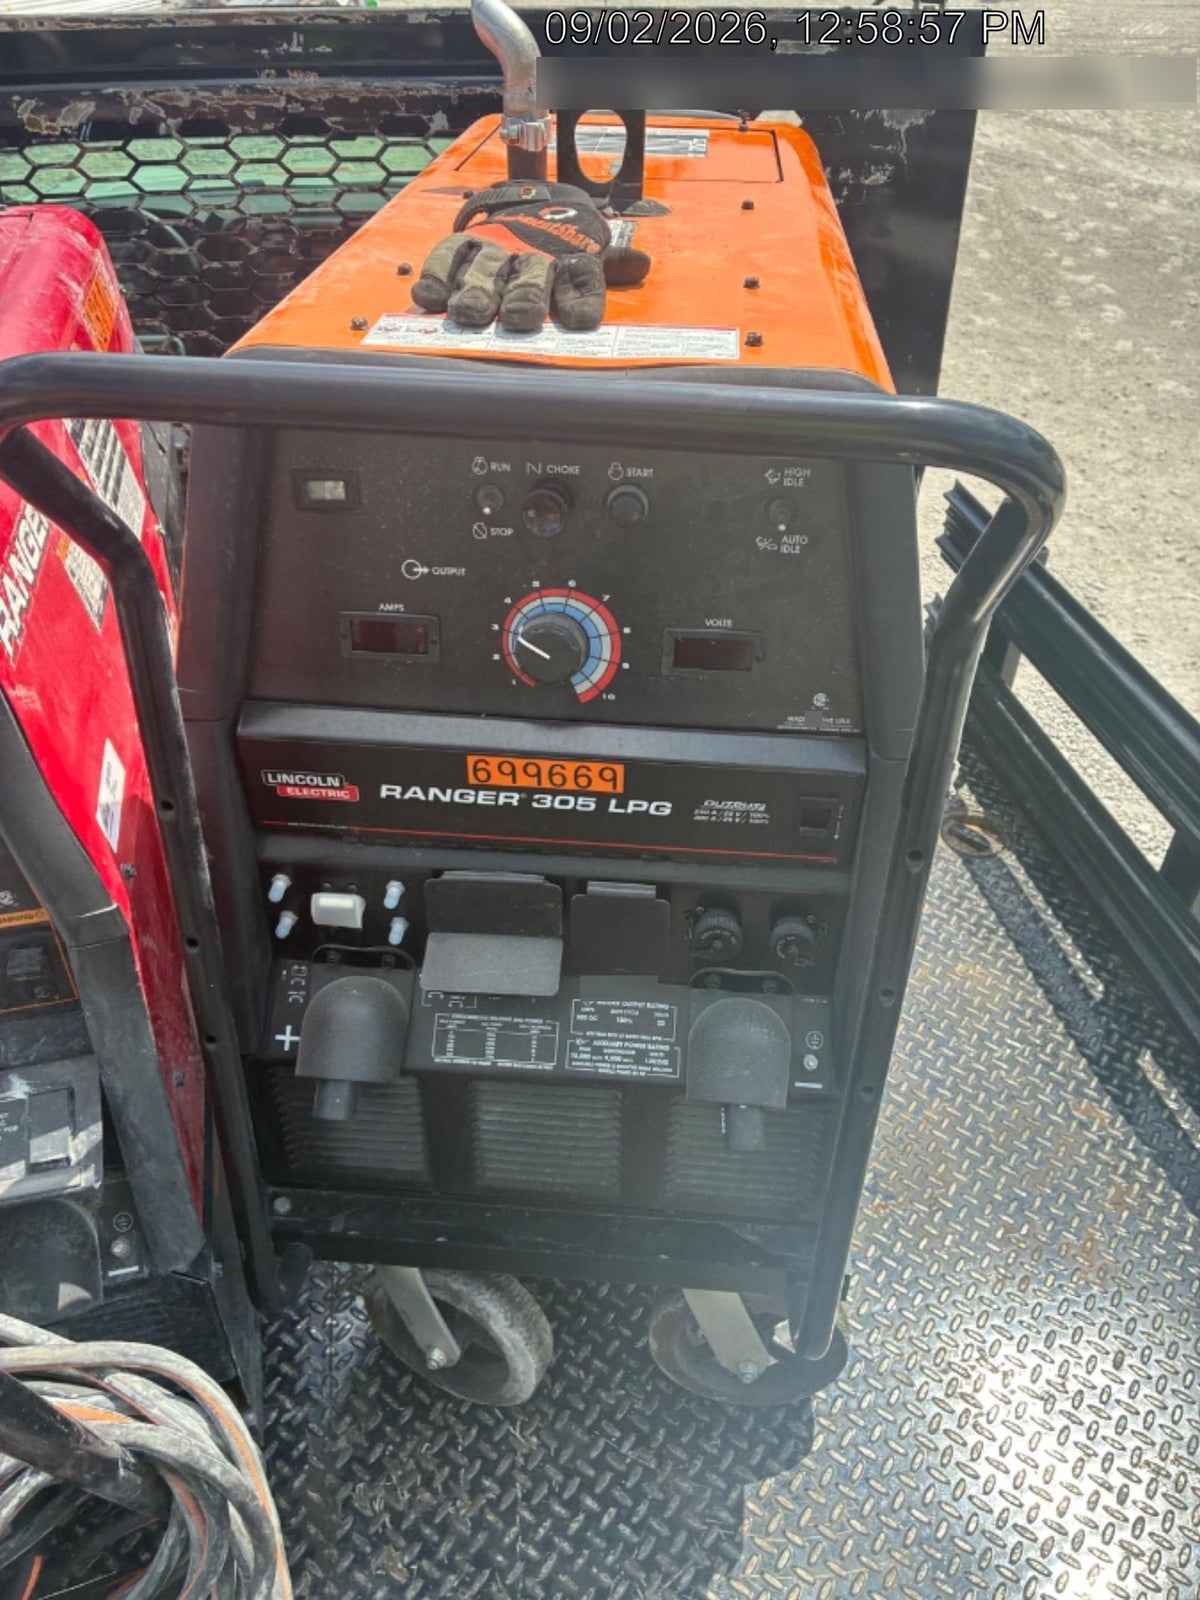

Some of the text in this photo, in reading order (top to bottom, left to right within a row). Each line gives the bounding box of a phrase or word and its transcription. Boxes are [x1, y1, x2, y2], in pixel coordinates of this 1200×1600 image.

[490, 463, 511, 472] RUN
[547, 465, 580, 475] CHOKE
[626, 467, 654, 477] START
[784, 467, 811, 477] HIGH
[784, 477, 804, 487] IDLE
[490, 527, 514, 537] STOP
[781, 534, 808, 544] AUTO
[780, 544, 800, 554] IDLE
[431, 566, 466, 576] OUTPUT
[379, 603, 405, 612] AMPS
[705, 618, 733, 628] VOLTS
[267, 772, 340, 787] LINCOLN
[472, 759, 618, 790] 699669
[286, 786, 351, 799] ELECTRIC
[380, 784, 520, 806] RANGER
[531, 793, 597, 812] 305
[608, 798, 673, 816] LPG
